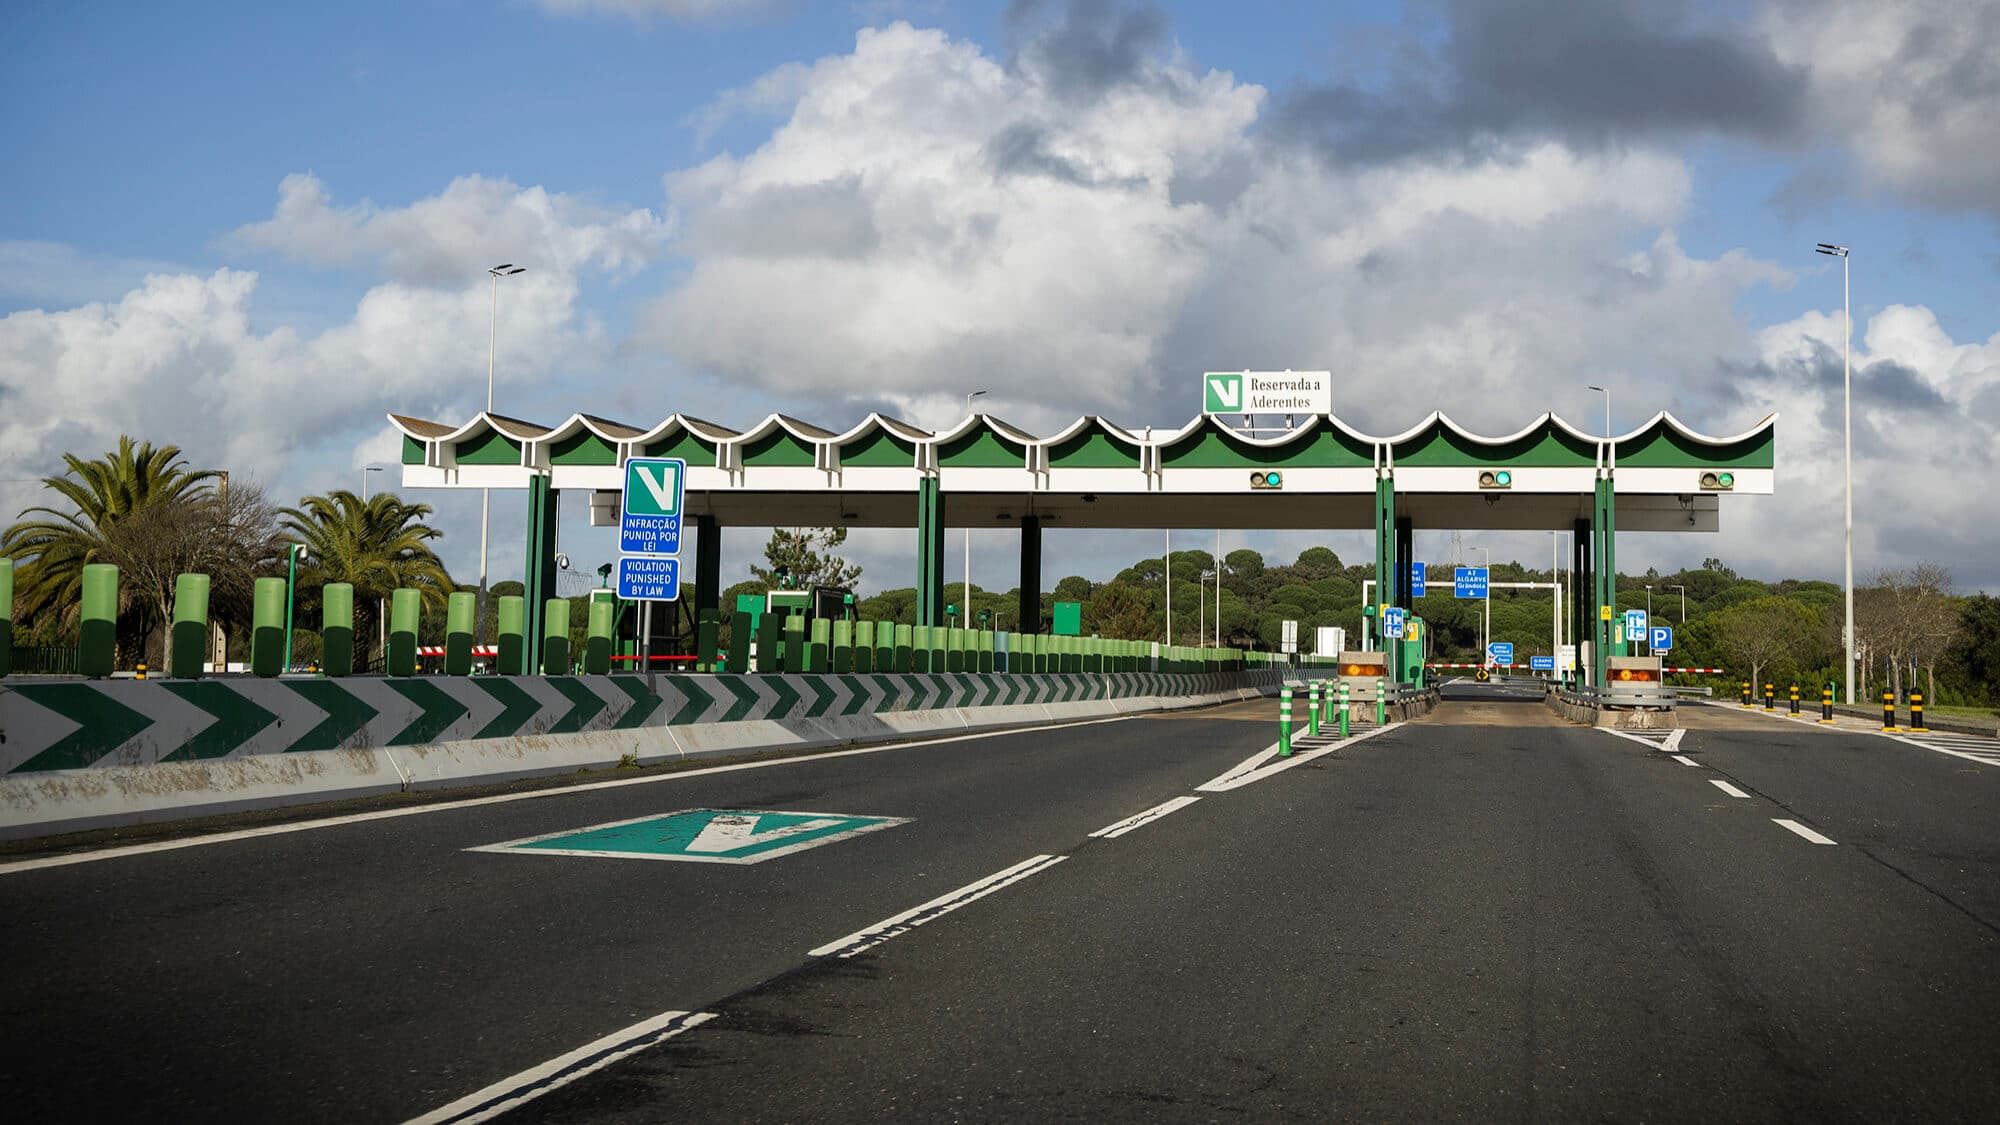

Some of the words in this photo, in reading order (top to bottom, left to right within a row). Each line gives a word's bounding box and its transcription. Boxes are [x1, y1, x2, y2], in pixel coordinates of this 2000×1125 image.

[1251, 378, 1311, 391] Reservada
[1314, 382, 1321, 391] a
[1250, 395, 1311, 409] Aderentes
[625, 518, 677, 531] INFRACÇÃO
[623, 530, 657, 541] PUNIDA
[659, 531, 677, 542] POR
[643, 541, 656, 551] LEI
[626, 561, 672, 572] VIOLATION
[625, 573, 671, 584] PUNISHED
[631, 585, 643, 595] BY
[645, 586, 664, 597] LAW
[1654, 629, 1667, 647] P
